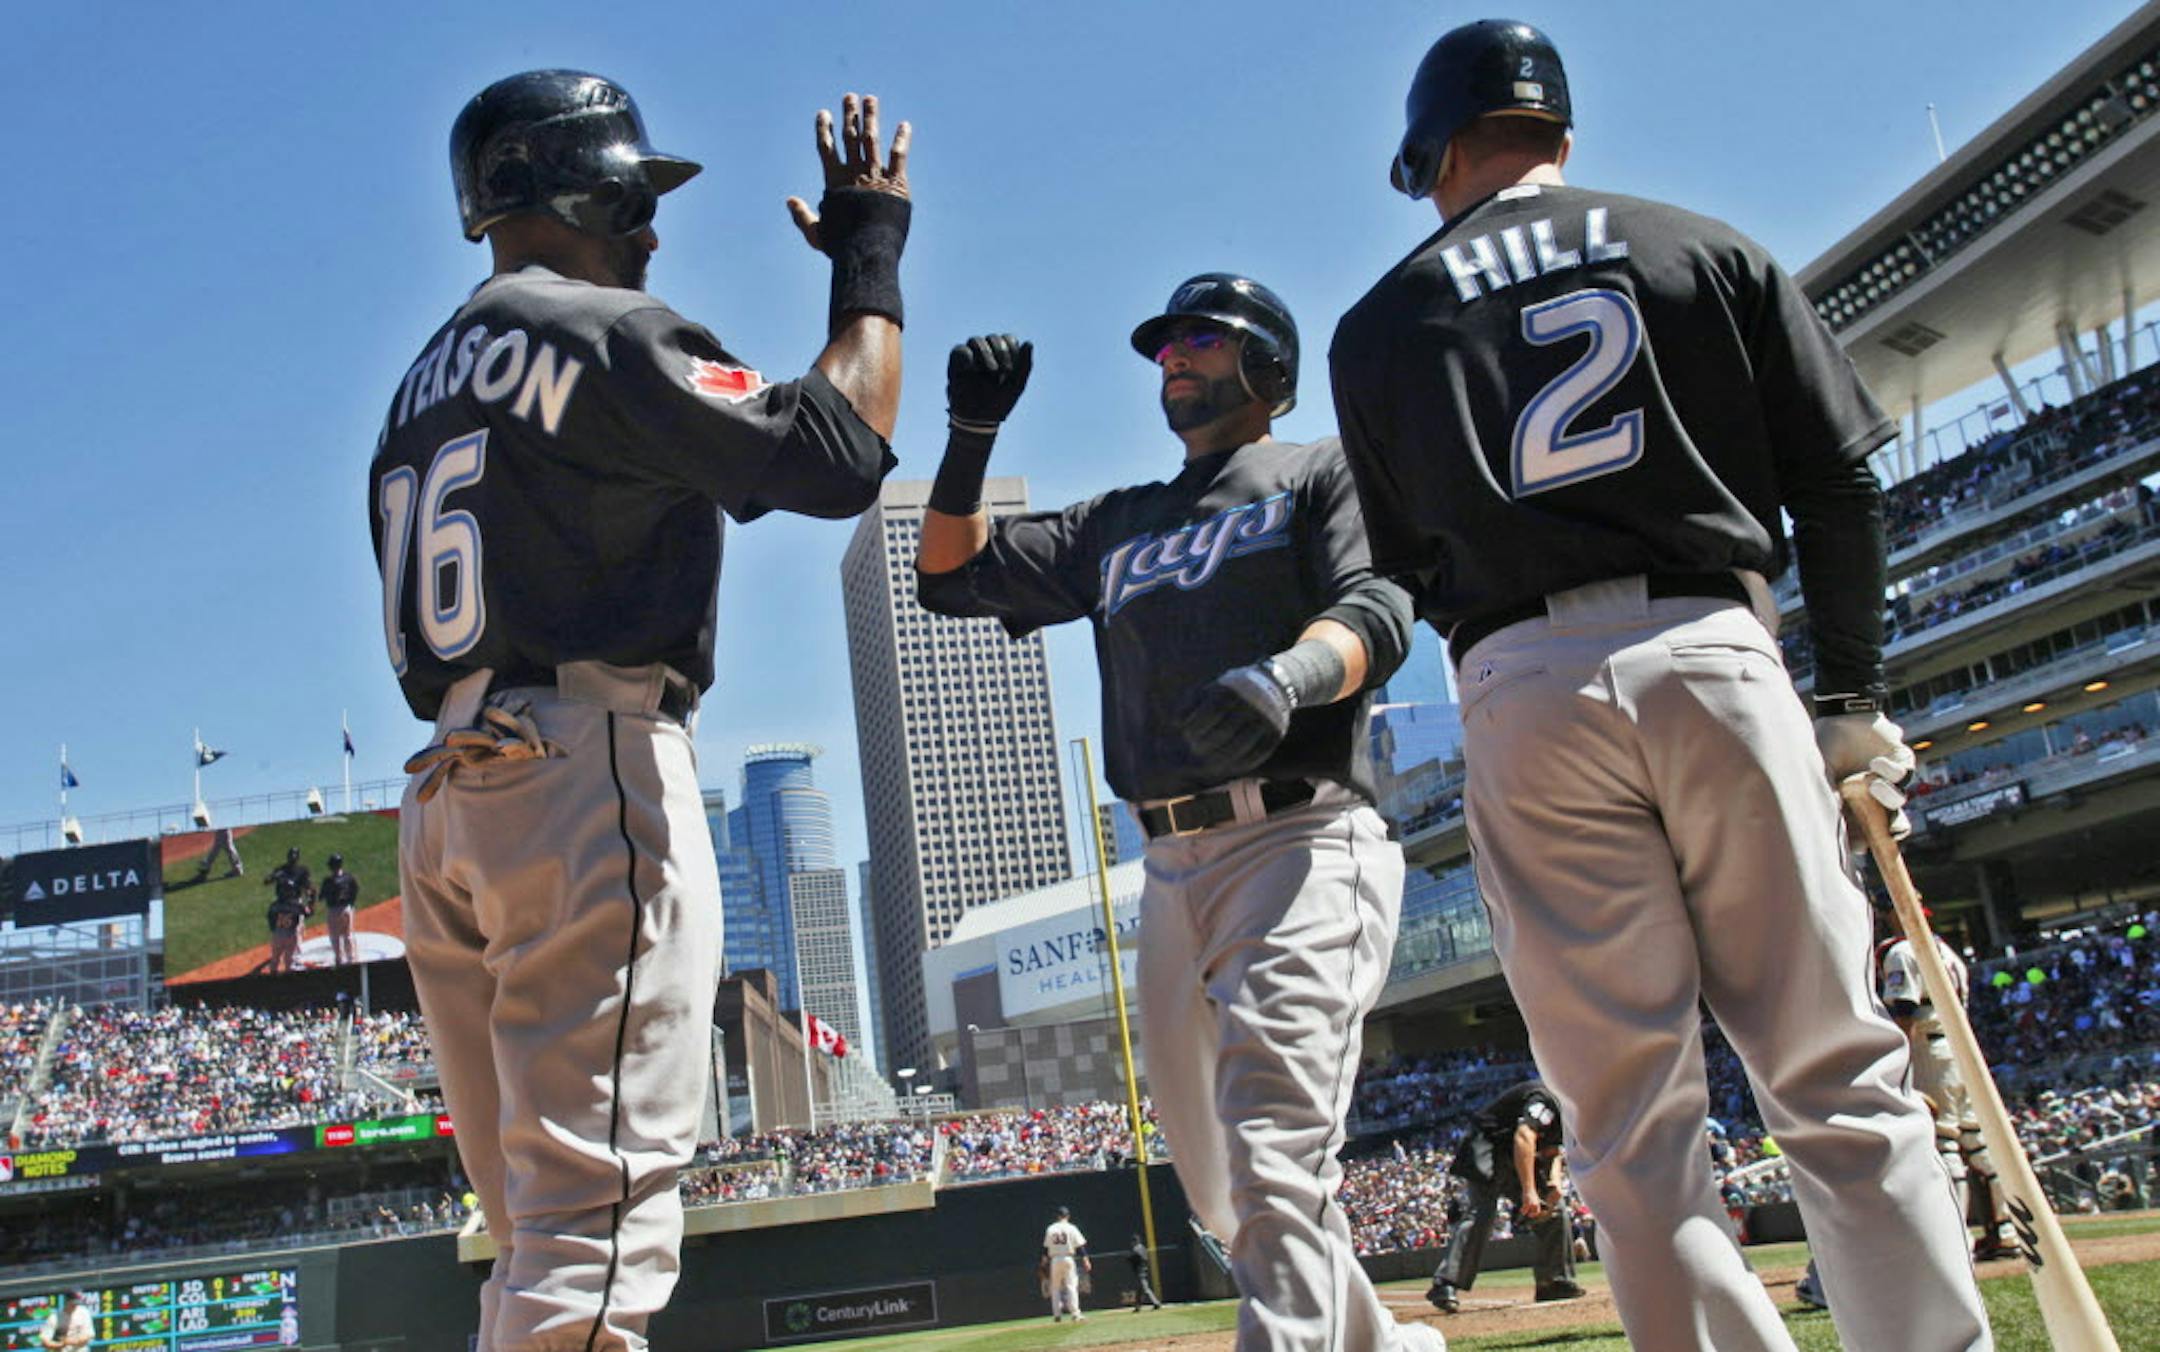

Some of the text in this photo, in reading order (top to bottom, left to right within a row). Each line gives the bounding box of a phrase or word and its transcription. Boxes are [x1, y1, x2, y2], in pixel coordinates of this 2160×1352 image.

[1520, 56, 1533, 79] 2
[1440, 207, 1629, 303] HILL
[1510, 287, 1645, 498] 2
[379, 427, 489, 677] 16
[1099, 488, 1294, 628] Jays
[53, 868, 140, 896] DELTA
[14, 1150, 77, 1167] DIAMOND
[23, 1162, 68, 1178] NOTES
[182, 1279, 204, 1292] SD
[178, 1290, 209, 1305] COL
[816, 1299, 910, 1322] CenturyLink
[179, 1317, 210, 1333] LAD
